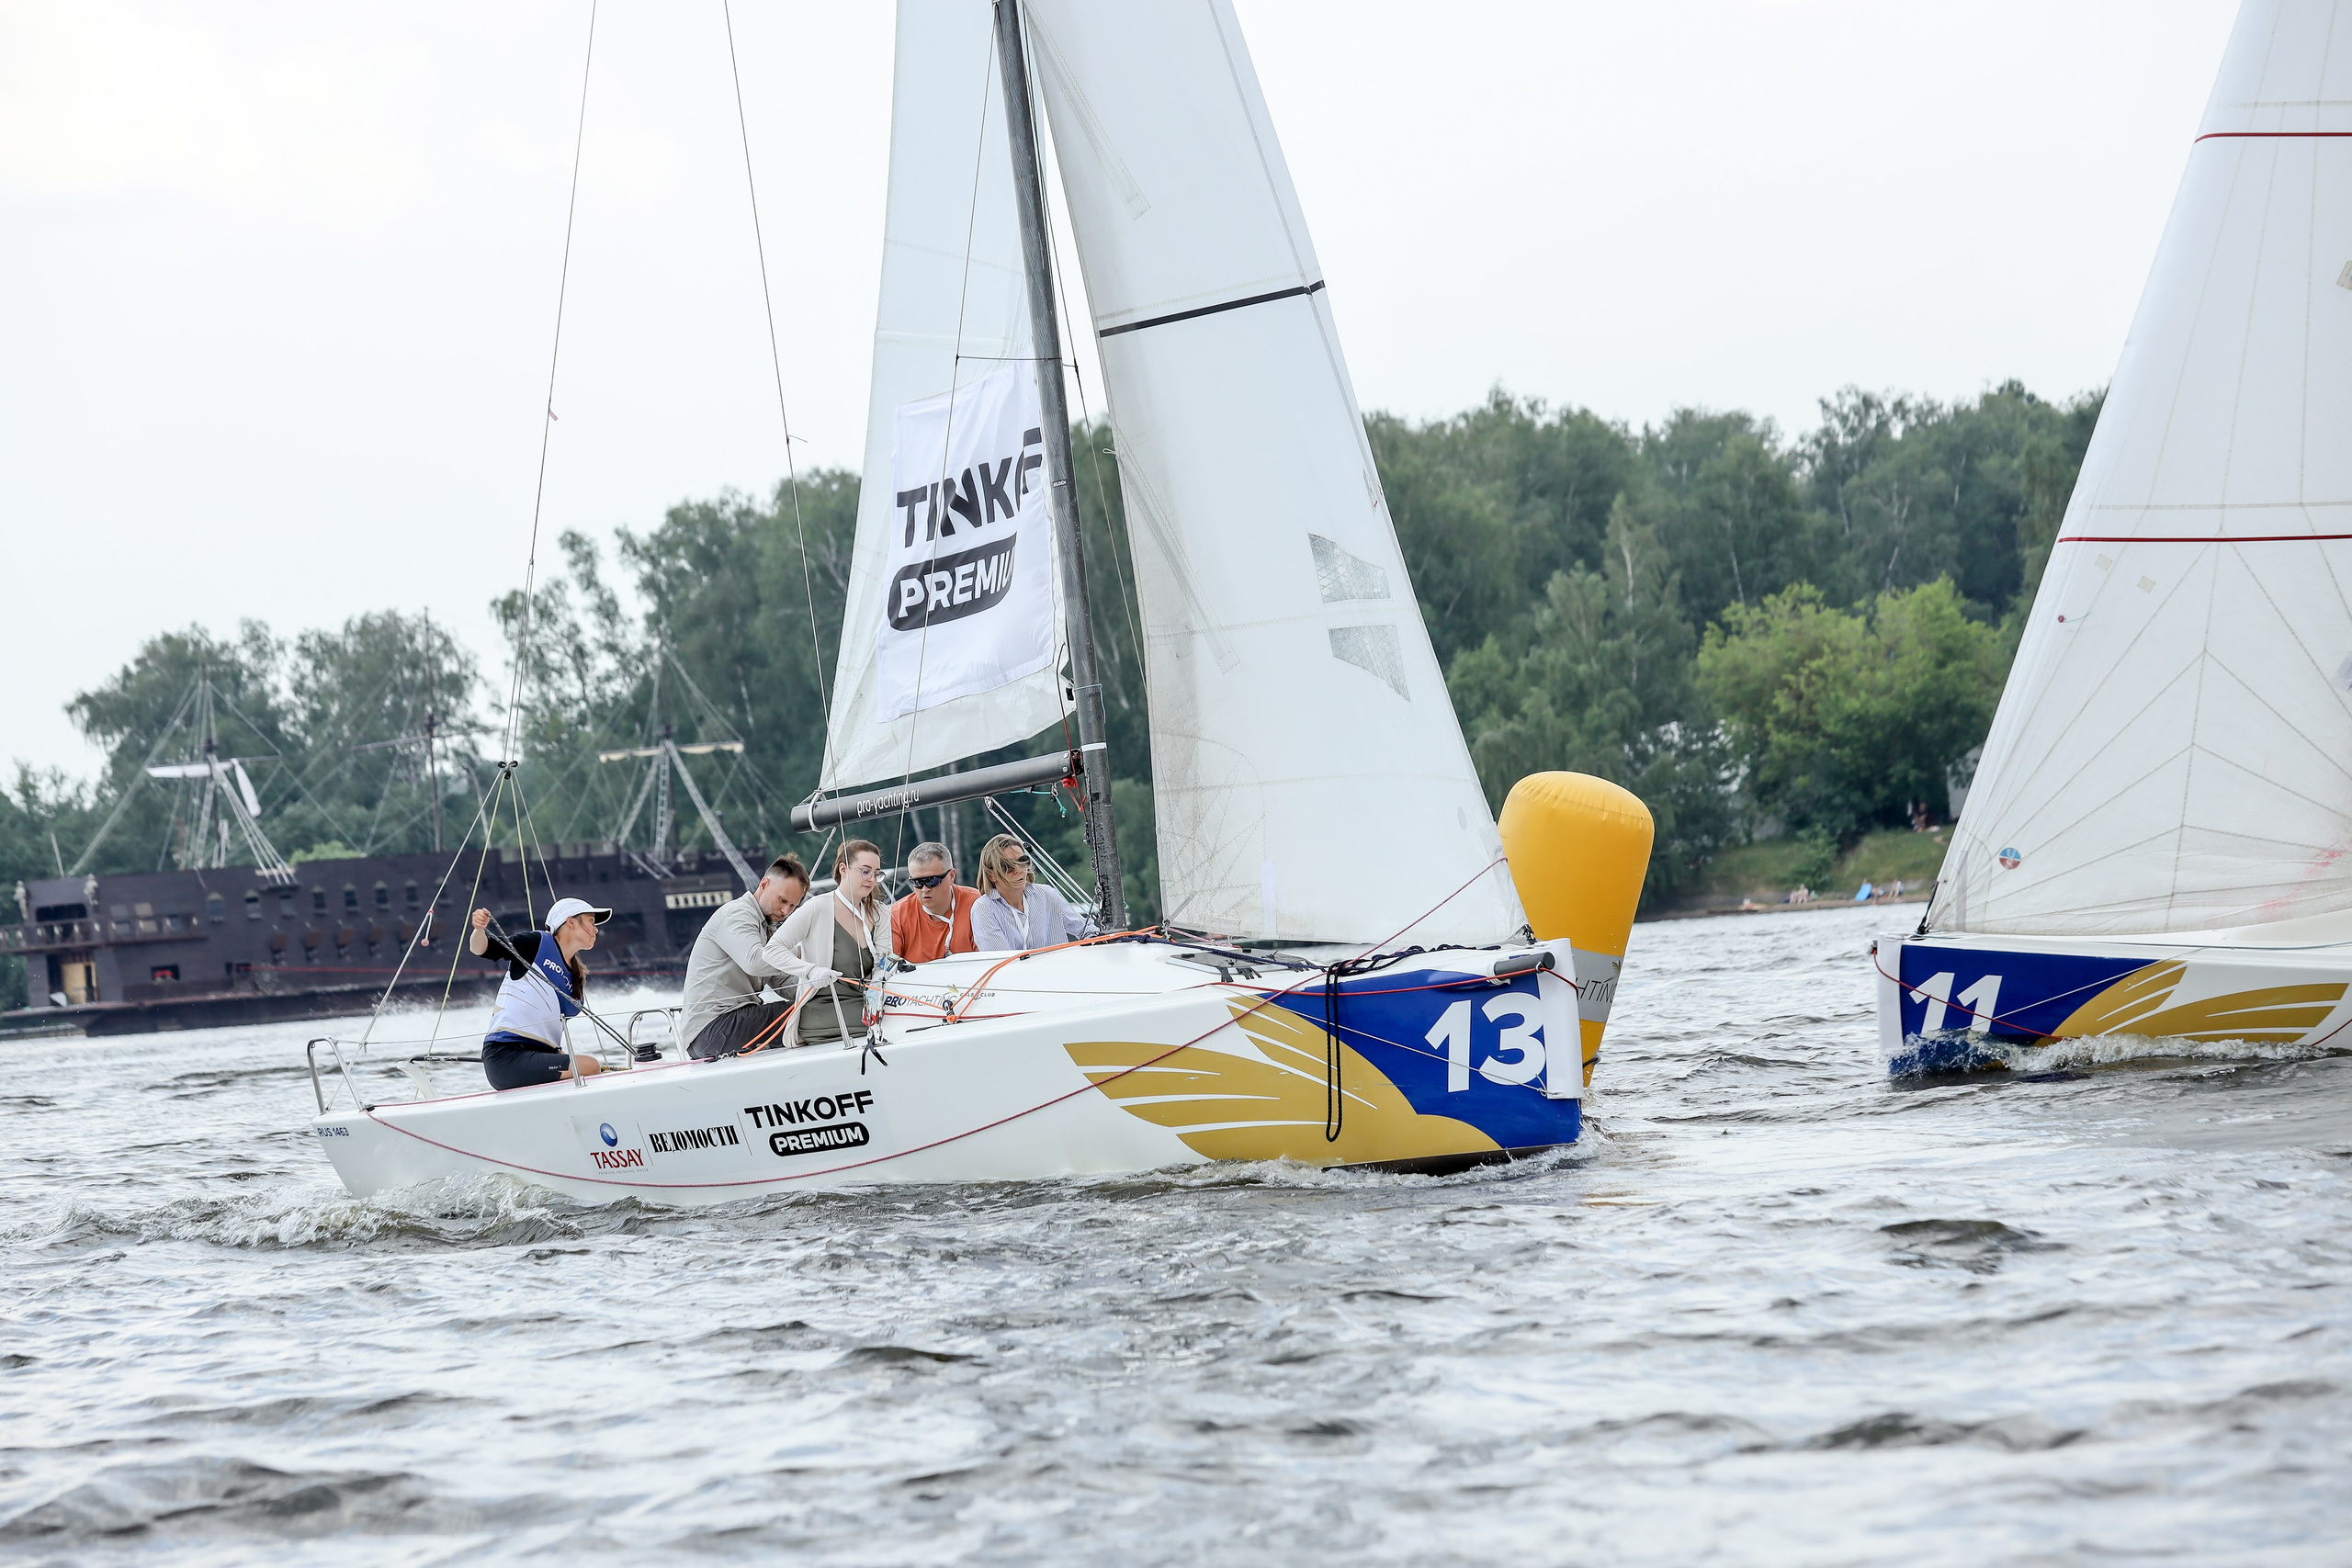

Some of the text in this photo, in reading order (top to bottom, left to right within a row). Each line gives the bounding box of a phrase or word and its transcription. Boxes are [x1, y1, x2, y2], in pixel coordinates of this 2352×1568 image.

[856, 788, 920, 818] pro-yachting.ru
[1909, 972, 2003, 1035] 11
[1424, 992, 1546, 1093] 13
[744, 1090, 875, 1129] TINKOFF
[317, 1127, 349, 1137] RUS 1463
[648, 1124, 740, 1154] ВЕДОМОСТИ
[774, 1125, 865, 1153] PREMIUM
[589, 1148, 644, 1168] TASSAY
